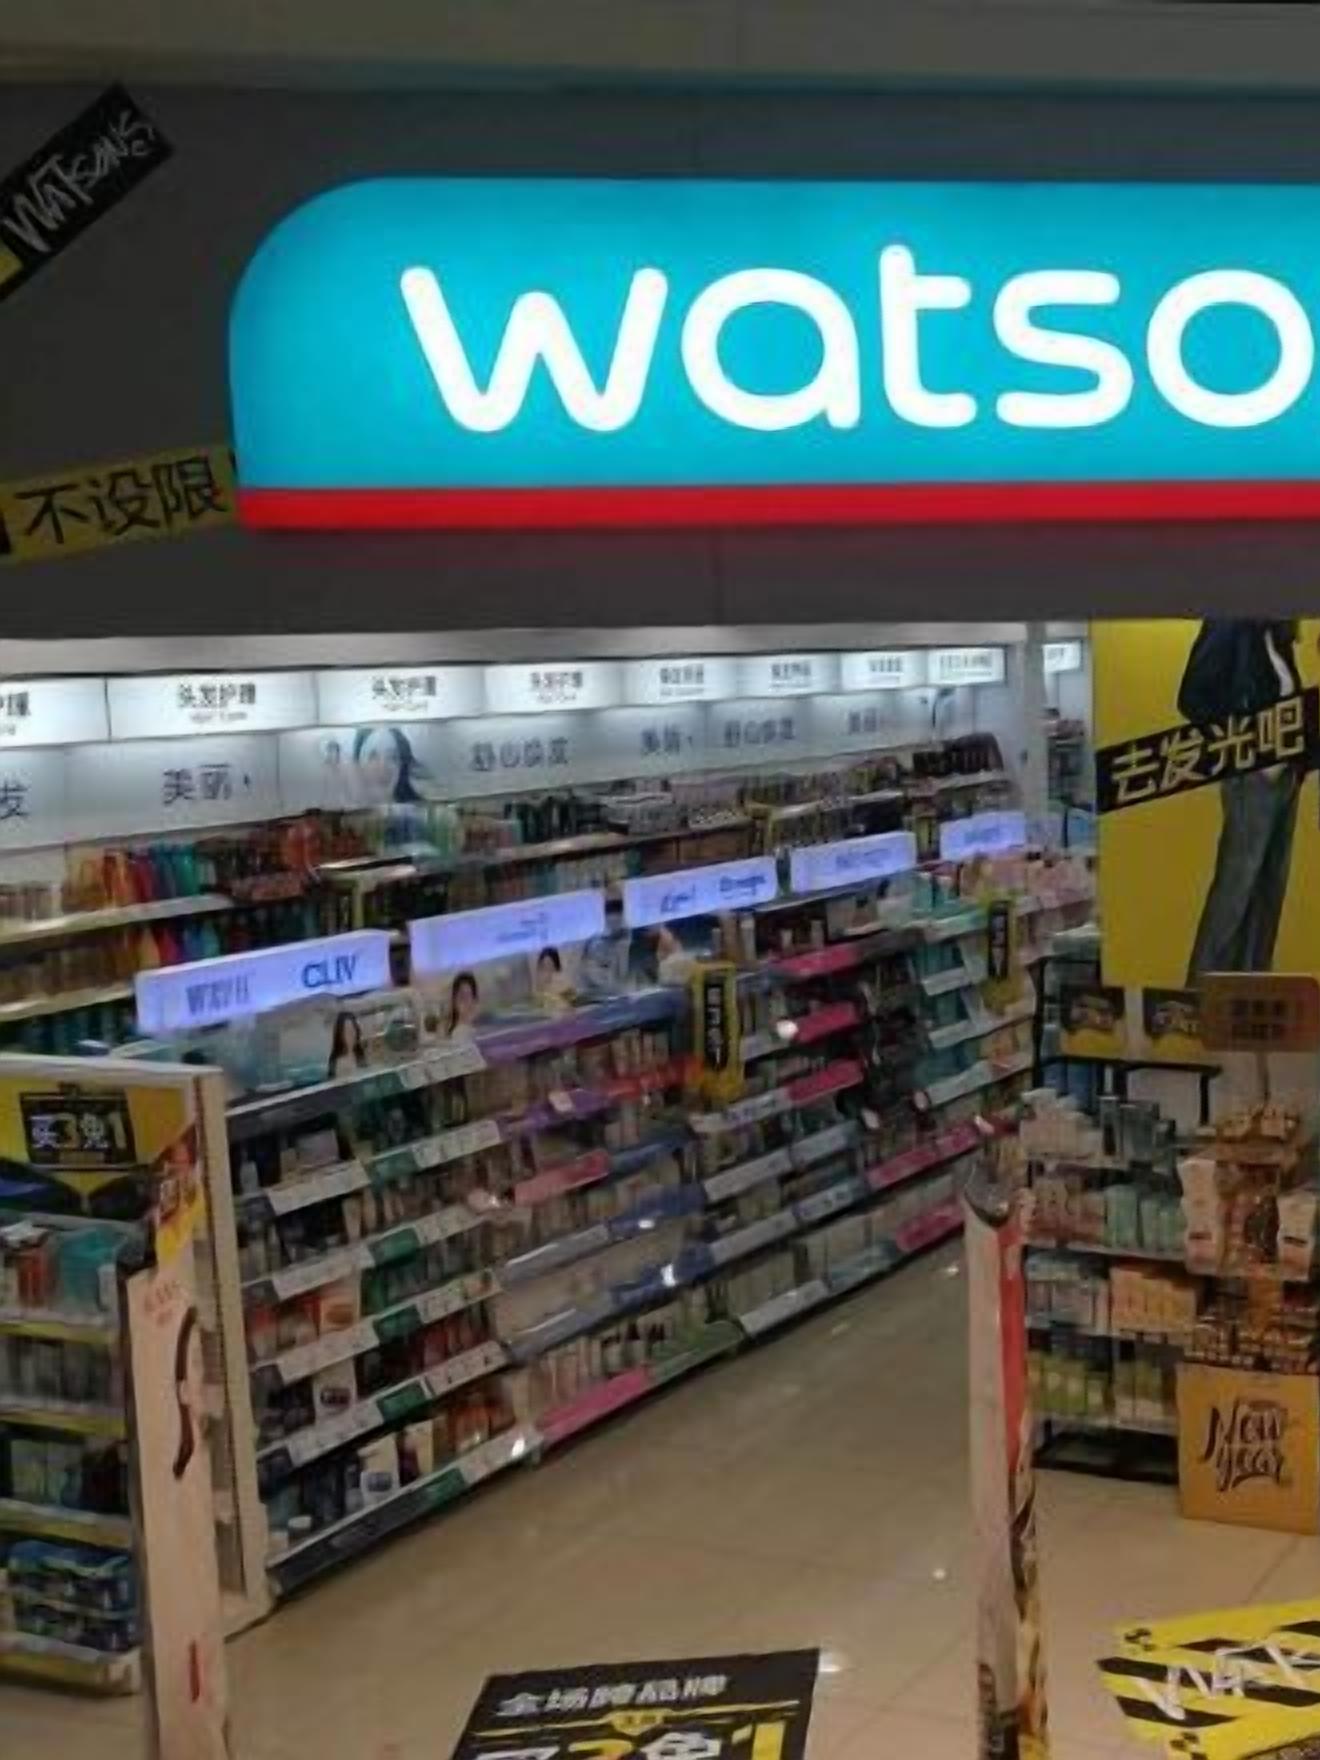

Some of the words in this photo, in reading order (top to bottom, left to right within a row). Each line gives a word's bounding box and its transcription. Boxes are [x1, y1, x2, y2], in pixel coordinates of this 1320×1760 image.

[13, 455, 230, 545] 不设限
[1111, 695, 1306, 802] 去发光吧
